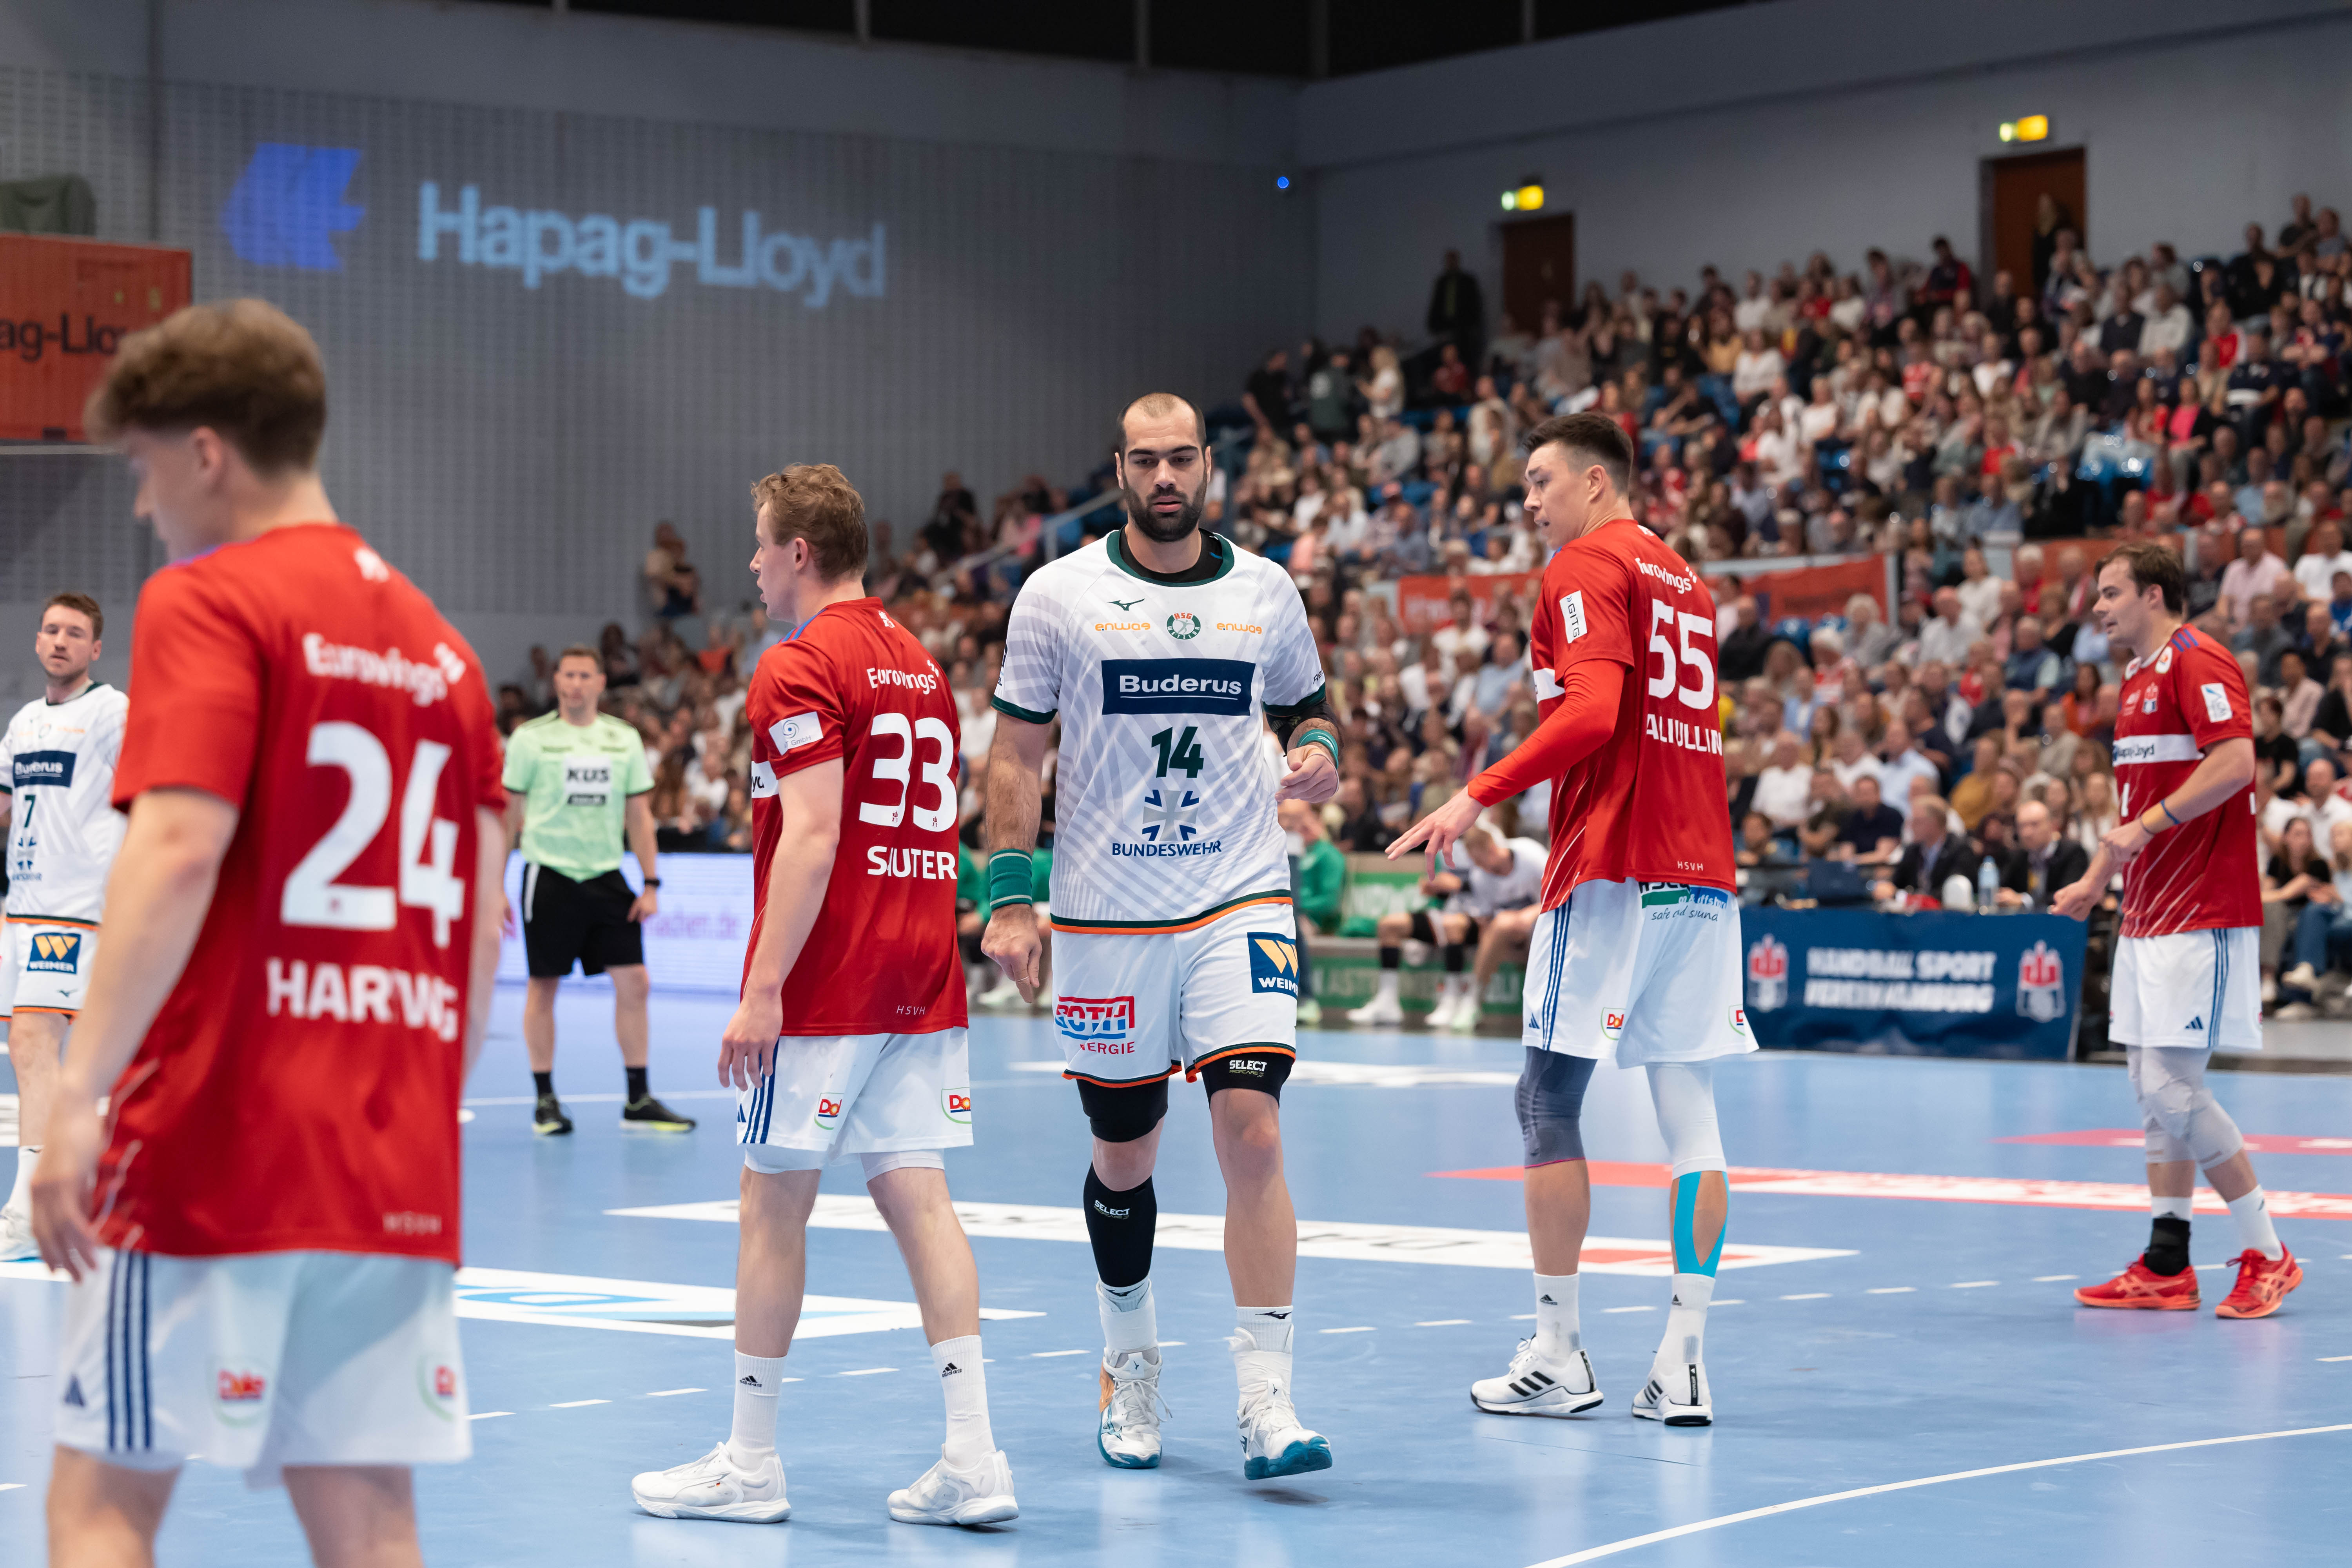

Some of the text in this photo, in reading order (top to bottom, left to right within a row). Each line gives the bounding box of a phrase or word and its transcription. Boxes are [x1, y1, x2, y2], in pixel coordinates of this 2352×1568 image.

[418, 180, 887, 309] Hapag-Lloyd
[1167, 626, 1200, 640] WETZLAR
[1648, 598, 1715, 710] 55
[1119, 674, 1242, 695] Buderus
[1151, 726, 1204, 778] 14
[859, 713, 957, 832] 33
[24, 795, 36, 828] 7
[281, 720, 465, 949] 24
[1112, 840, 1222, 857] BUNDESWEHR
[1677, 861, 1704, 871] HSVH
[29, 960, 74, 972] WEIMER
[896, 1004, 926, 1015] HSVH
[1055, 1004, 1127, 1032] ROTH
[1229, 1060, 1267, 1072] SELECT
[1094, 1200, 1130, 1216] SELECT
[942, 1368, 962, 1378] adidas
